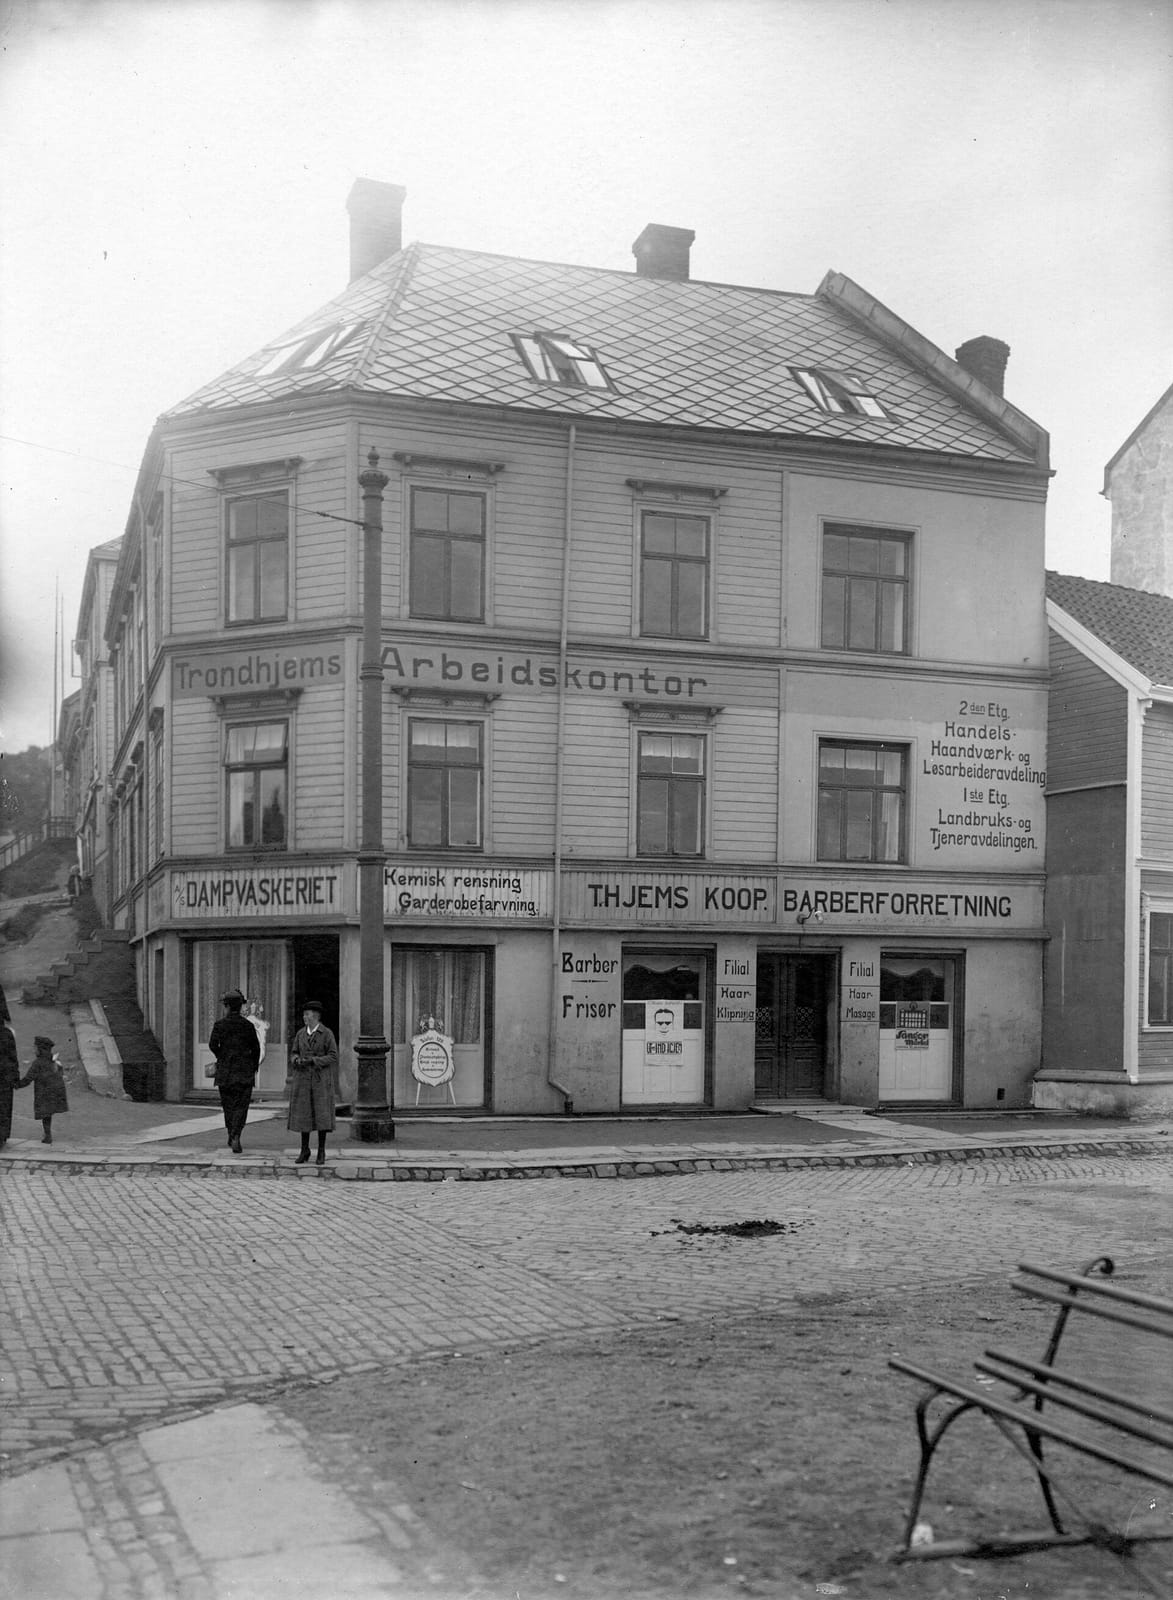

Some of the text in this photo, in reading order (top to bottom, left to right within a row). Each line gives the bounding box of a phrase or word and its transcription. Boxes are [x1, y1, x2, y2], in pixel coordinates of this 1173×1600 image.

[175, 646, 708, 698] Trondhjems Arbeidskontor
[988, 702, 1011, 722] Etg.
[944, 721, 1017, 742] Handels-
[1018, 752, 1031, 766] og
[923, 759, 1047, 788] Løsarbeideravdeling
[988, 789, 1011, 809] Etg.
[1018, 818, 1032, 833] og
[929, 828, 1038, 852] Tjeneravdelingen.
[186, 875, 338, 908] DAMPVASKERIET
[383, 867, 522, 894] Kemisk rensning
[398, 891, 540, 917] Garderobefarvning.
[704, 886, 768, 911] KOOP.
[783, 889, 1012, 918] BARBERFORRETNING
[561, 951, 619, 974] Barber
[723, 958, 750, 976] Filial
[850, 962, 874, 977] Filial
[561, 994, 617, 1019] Frisør
